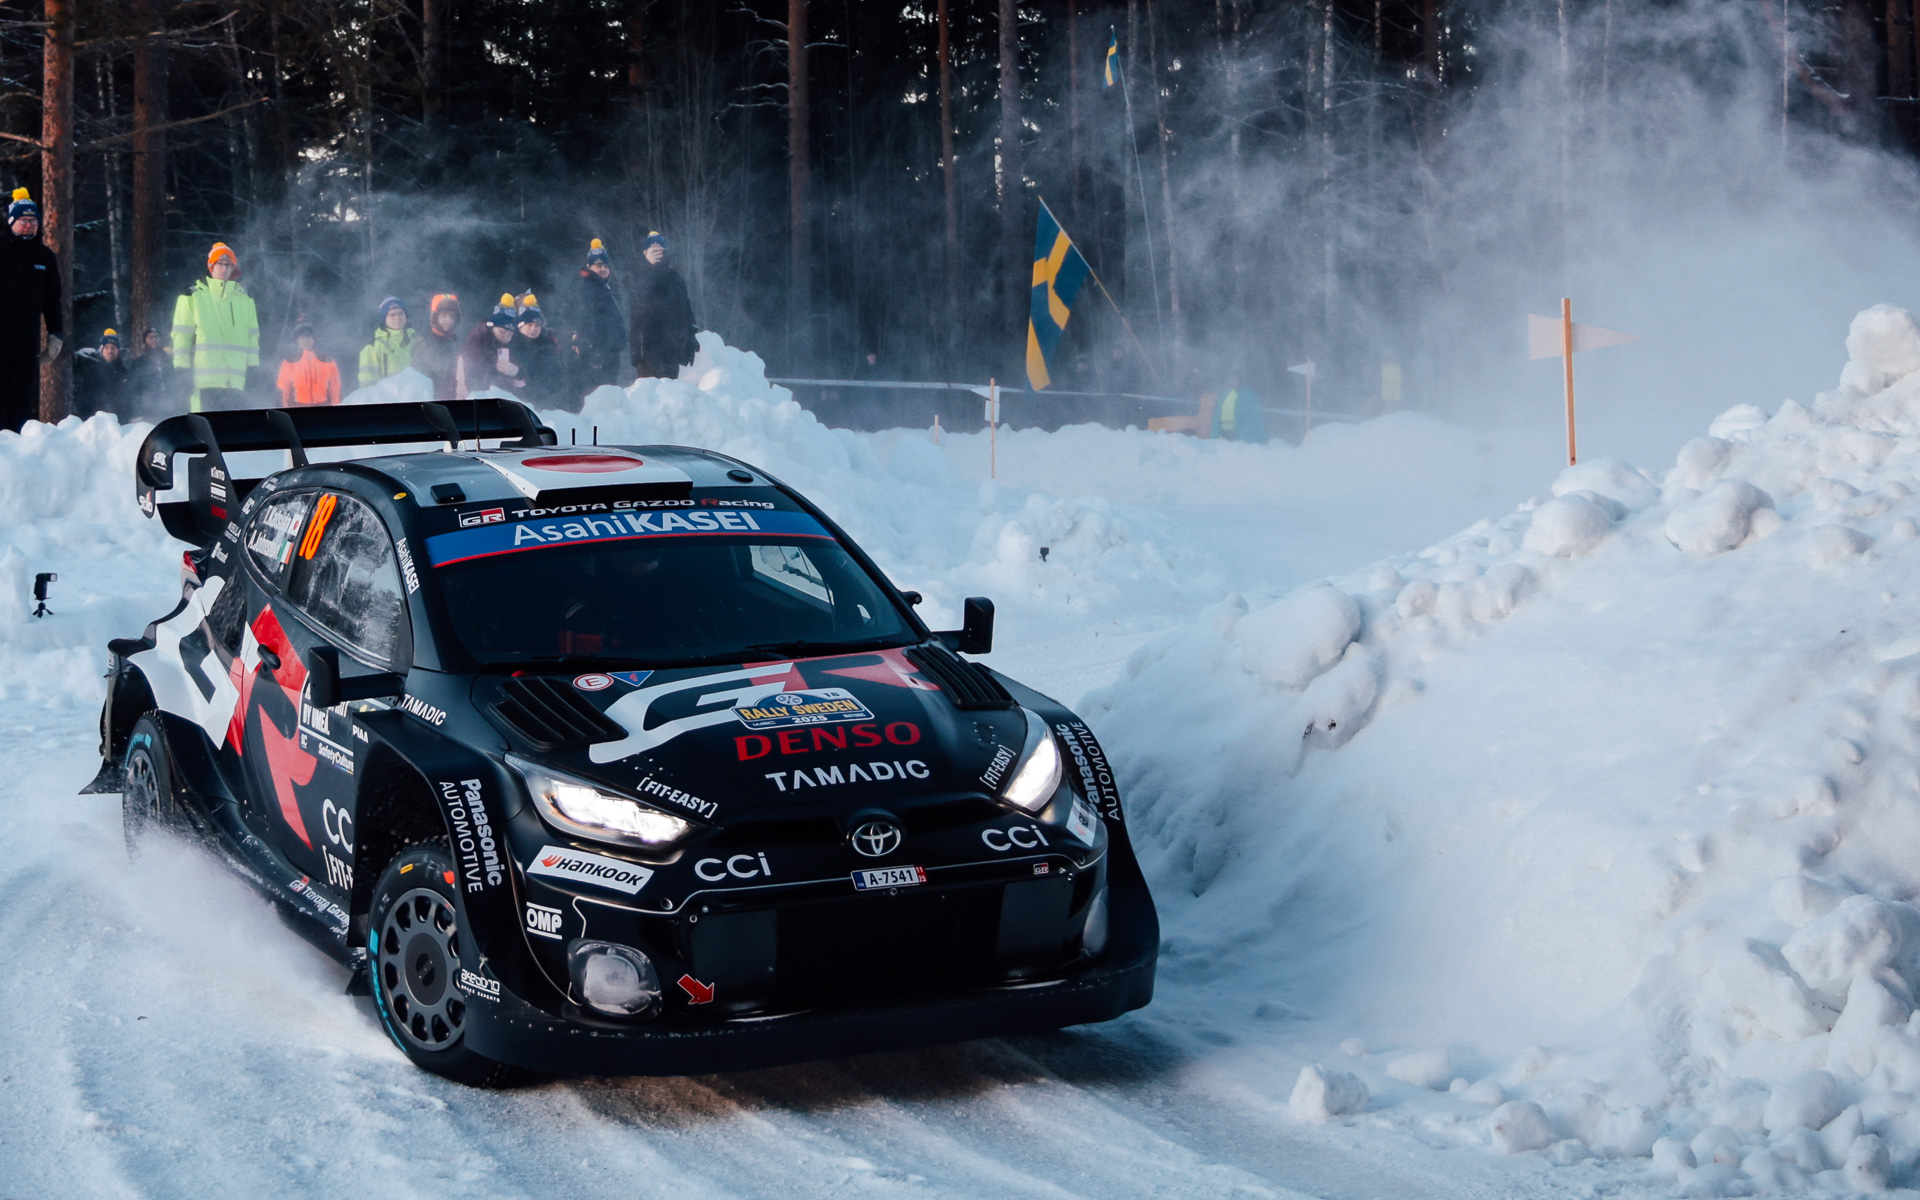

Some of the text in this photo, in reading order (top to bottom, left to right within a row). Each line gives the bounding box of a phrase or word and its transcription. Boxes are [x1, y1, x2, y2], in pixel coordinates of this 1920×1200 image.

[298, 493, 338, 560] 18
[460, 498, 775, 527] GR TOYOTA GAZOO Racing
[513, 511, 761, 546] AsahiKASEI
[396, 537, 420, 595] AsahiKASEI
[400, 693, 447, 726] TAMADIC
[738, 699, 859, 721] RALLY SWEDEN
[792, 714, 829, 724] 2025
[352, 724, 369, 744] PIAA
[733, 721, 921, 761] DENSO
[764, 759, 931, 792] TAMADIC
[1069, 721, 1121, 821] AUTOMOTIVE
[439, 781, 484, 894] AUTOMOTIVE
[460, 778, 506, 887] Panasonic
[869, 870, 914, 886] A-7541
[526, 907, 563, 934] OMP
